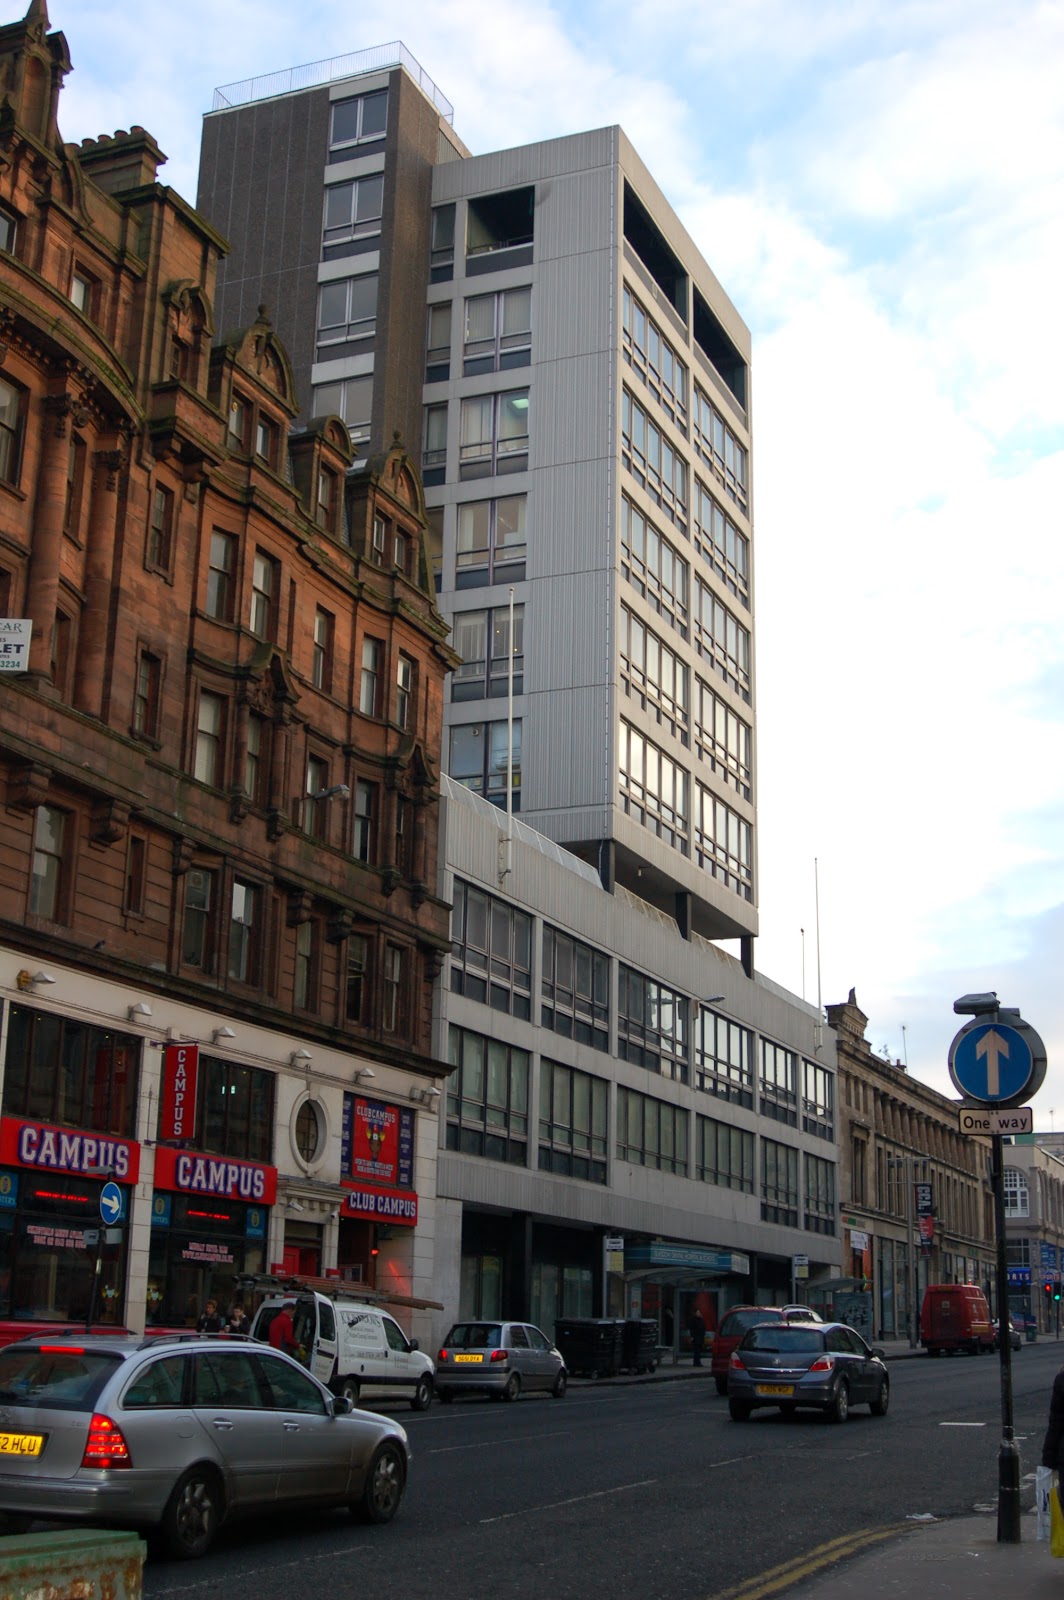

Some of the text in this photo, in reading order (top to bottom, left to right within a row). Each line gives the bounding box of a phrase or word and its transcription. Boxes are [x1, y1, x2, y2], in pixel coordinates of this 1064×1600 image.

[172, 1049, 186, 1135] CAMPUS
[963, 1115, 1027, 1130] One way
[21, 1127, 129, 1176] CAMPUS
[178, 1156, 265, 1198] CAMPUS
[349, 1191, 417, 1217] CLUB CAMPUS
